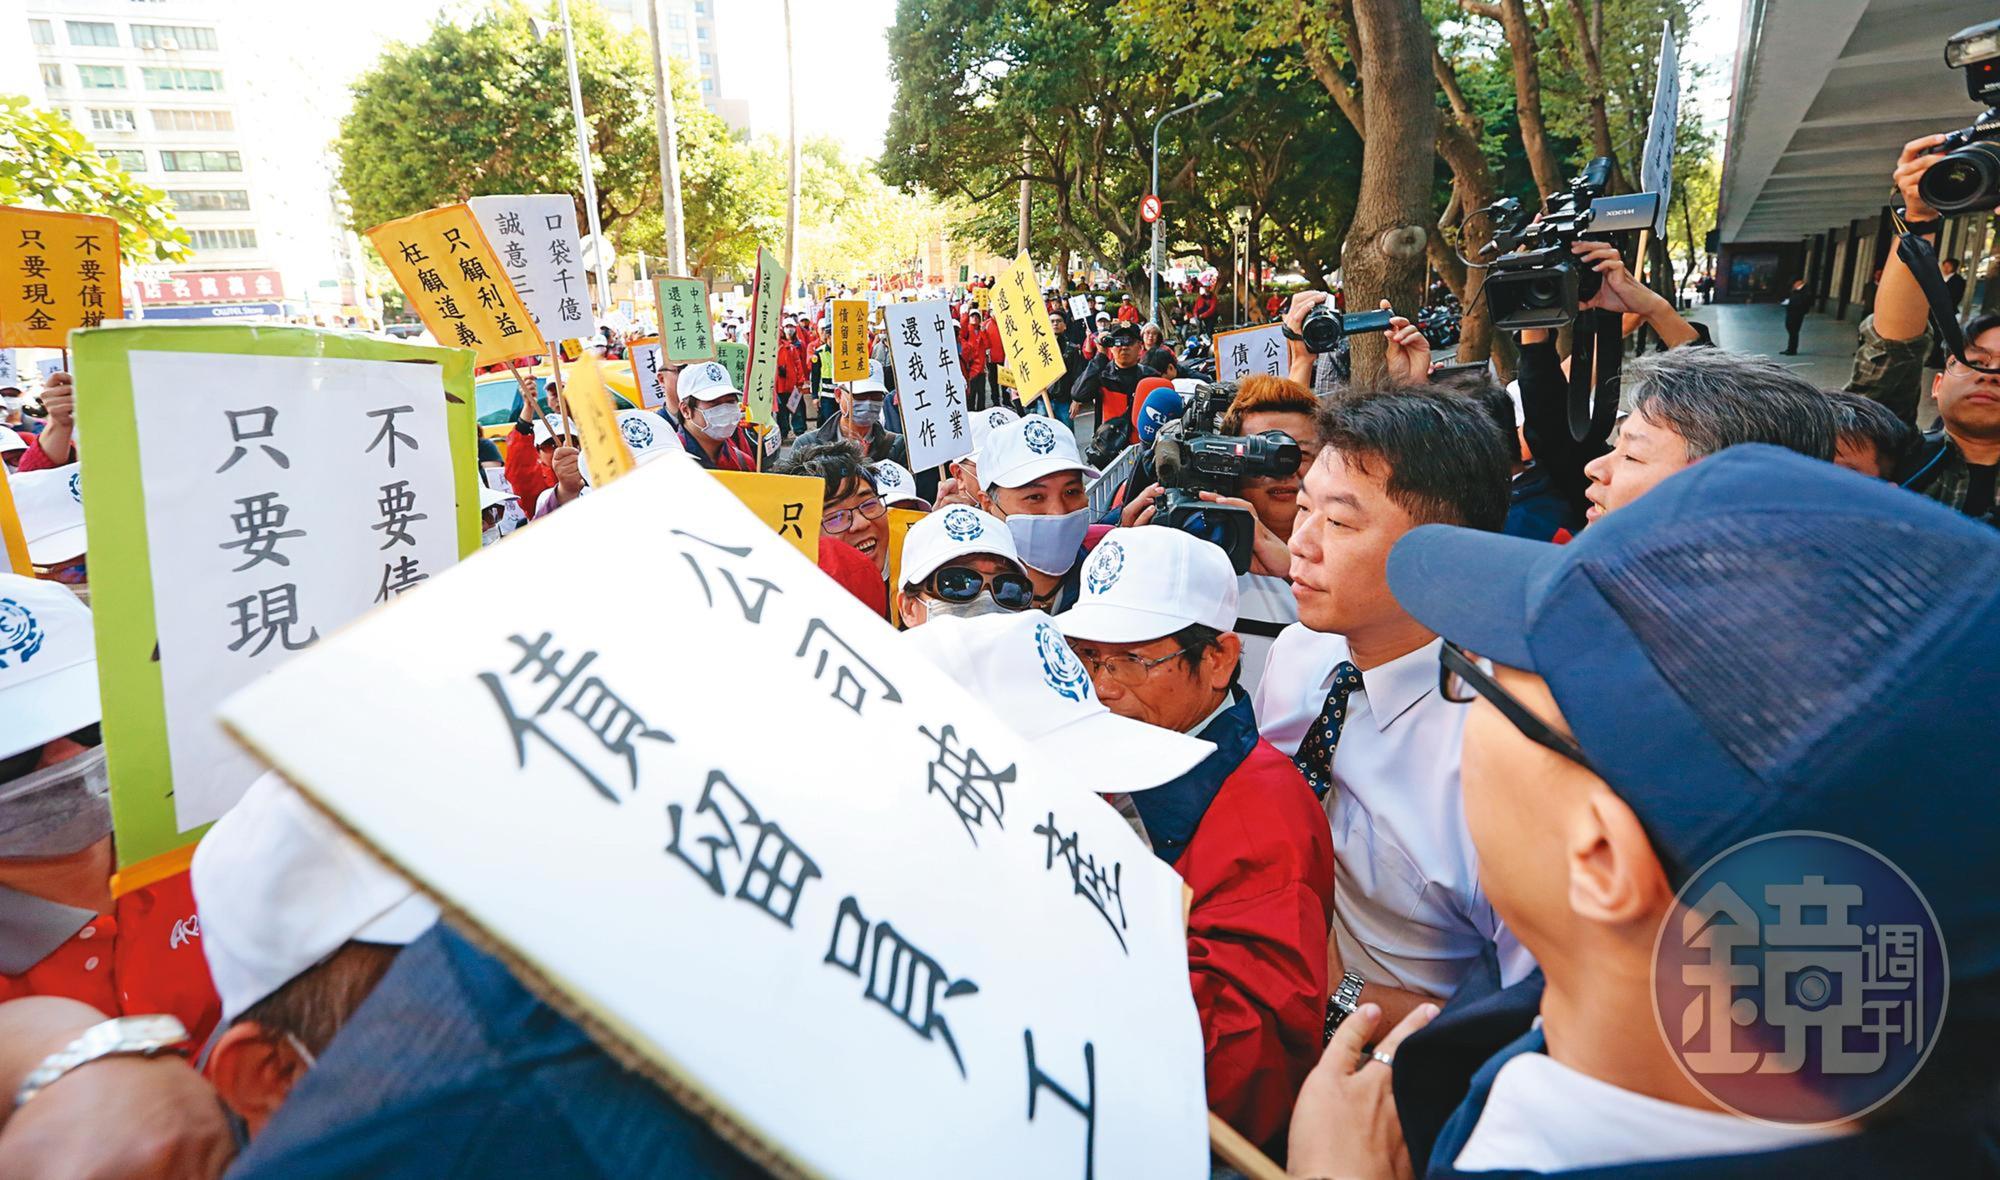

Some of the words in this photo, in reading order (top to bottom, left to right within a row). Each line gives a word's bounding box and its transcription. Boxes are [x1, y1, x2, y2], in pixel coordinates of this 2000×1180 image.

[18, 229, 56, 331] 只要現金
[398, 240, 484, 348] 枉顧道義
[442, 227, 524, 338] 只顧利益
[545, 214, 582, 322] 口袋千億
[668, 286, 688, 350] 還我工作
[690, 286, 707, 350] 中年失業
[1014, 270, 1053, 368] 中年失業
[839, 308, 851, 370] 債留員工
[856, 308, 866, 371] 公司破產
[901, 316, 938, 448] 還我工作
[933, 314, 963, 440] 中年失業
[997, 288, 1030, 384] 還我工作
[1264, 337, 1281, 376] 公司
[216, 405, 320, 658] 只要現
[669, 528, 1129, 955] 公司破產
[477, 630, 1097, 1180] 債留員工
